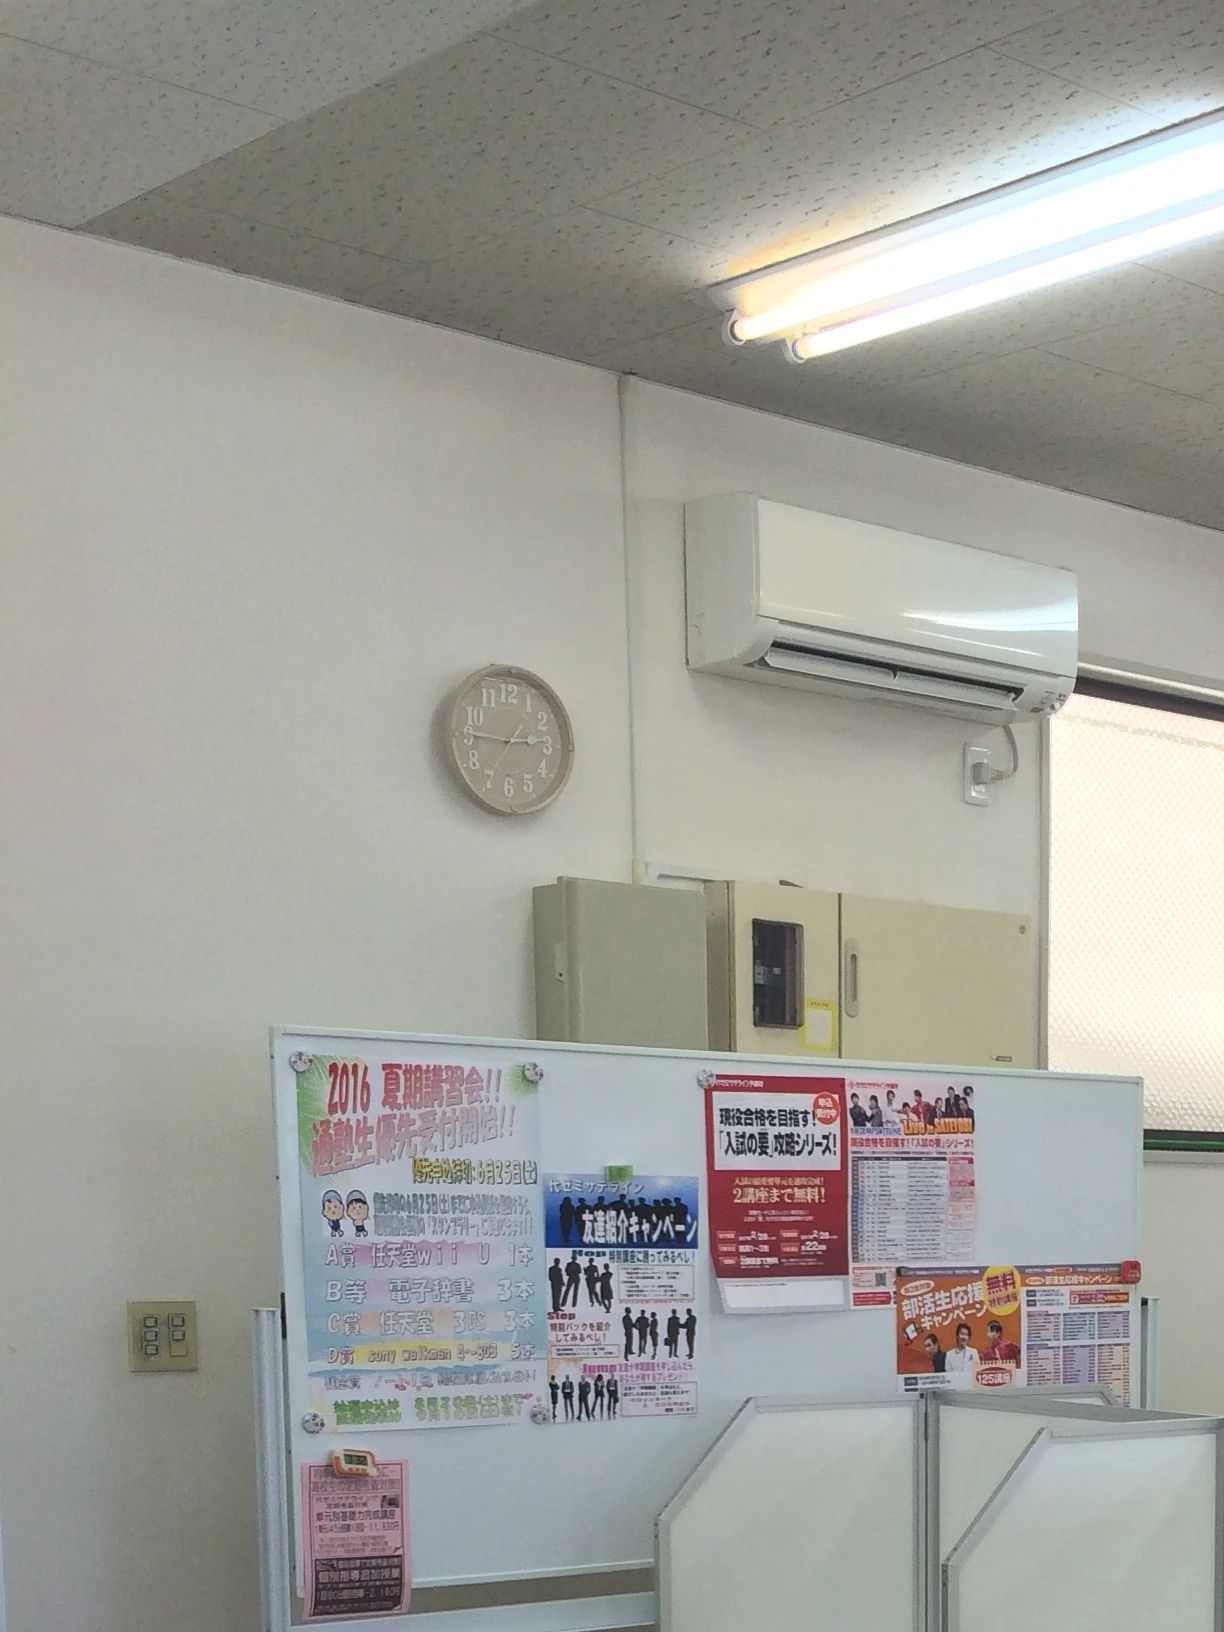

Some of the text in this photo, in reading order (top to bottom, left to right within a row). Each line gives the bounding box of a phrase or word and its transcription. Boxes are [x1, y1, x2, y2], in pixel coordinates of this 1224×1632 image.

[481, 689, 496, 707] 11
[500, 684, 517, 703] 12
[526, 694, 532, 712] 1
[466, 706, 483, 725] 10
[537, 712, 547, 731] 2
[464, 726, 474, 745] 9
[542, 736, 552, 755] 3
[469, 750, 479, 769] 8
[537, 759, 547, 777] 4
[484, 769, 494, 788] 7
[504, 777, 513, 796] 6
[523, 774, 533, 792] 5
[328, 1062, 502, 1115] 2016 夏期講習会!!
[719, 1108, 816, 1127] 現役合格を目指す!
[310, 1104, 516, 1176] 通塾生優先受付開始!!
[549, 1180, 645, 1194] 代ゼミサテライン
[733, 1187, 826, 1204] 2講座まで無料!
[582, 1208, 697, 1244] 友達紹介キャンペーン
[325, 1245, 355, 1268] A賞
[388, 1278, 474, 1302] 電子辞書
[497, 1279, 535, 1302] 3本
[987, 1271, 1016, 1290] 無料
[327, 1311, 537, 1336] C賞 任天堂 3DS 3本
[921, 1304, 987, 1330] キャンペーン
